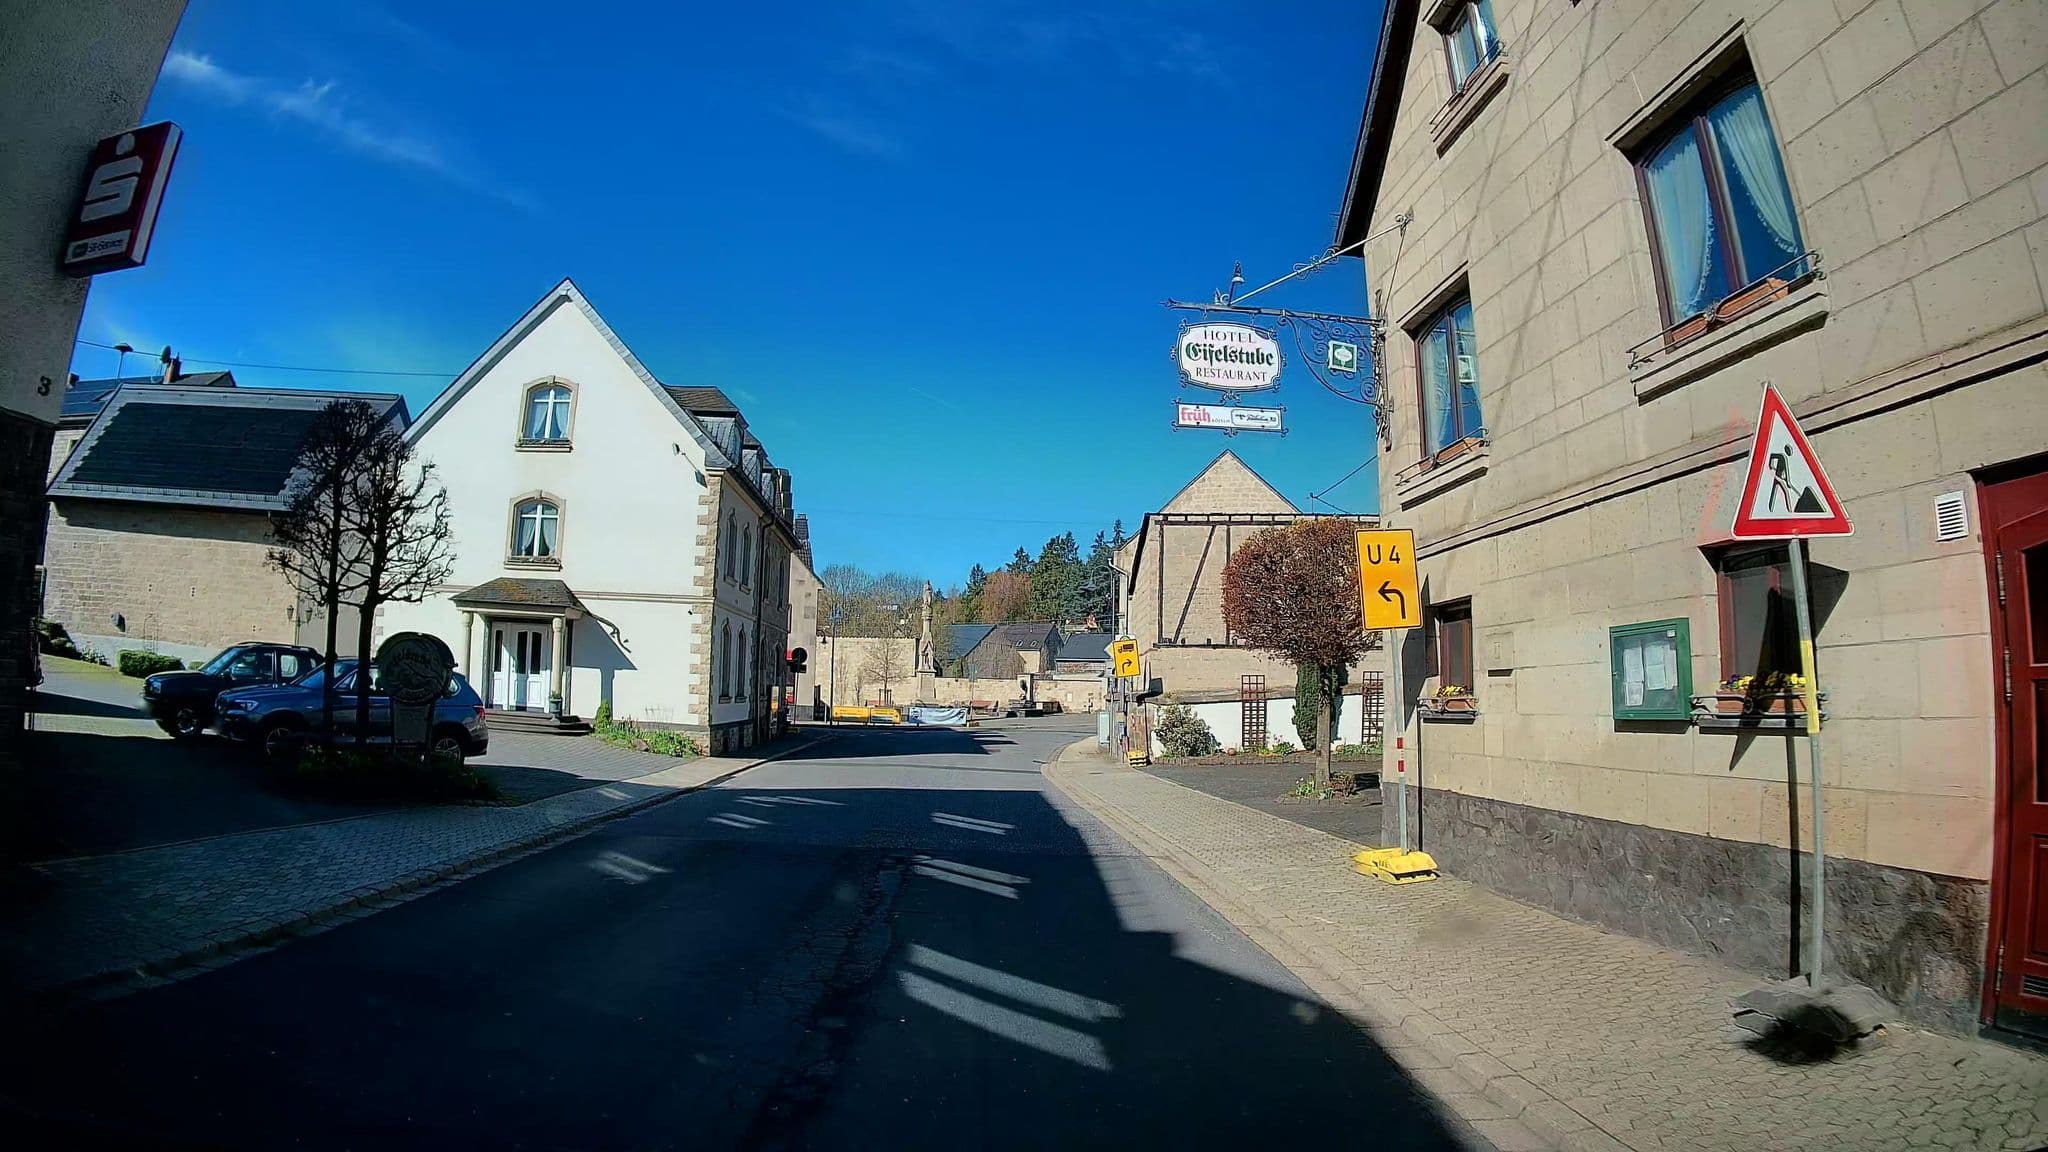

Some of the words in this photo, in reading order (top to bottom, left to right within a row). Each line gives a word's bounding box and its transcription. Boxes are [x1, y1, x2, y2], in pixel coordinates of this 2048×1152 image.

[1203, 329, 1257, 344] HOTEL
[1185, 342, 1274, 366] Eifelstube
[1196, 367, 1267, 382] RESTAURANT
[38, 376, 51, 396] 3
[1367, 544, 1381, 565] U
[1389, 545, 1401, 564] 4
